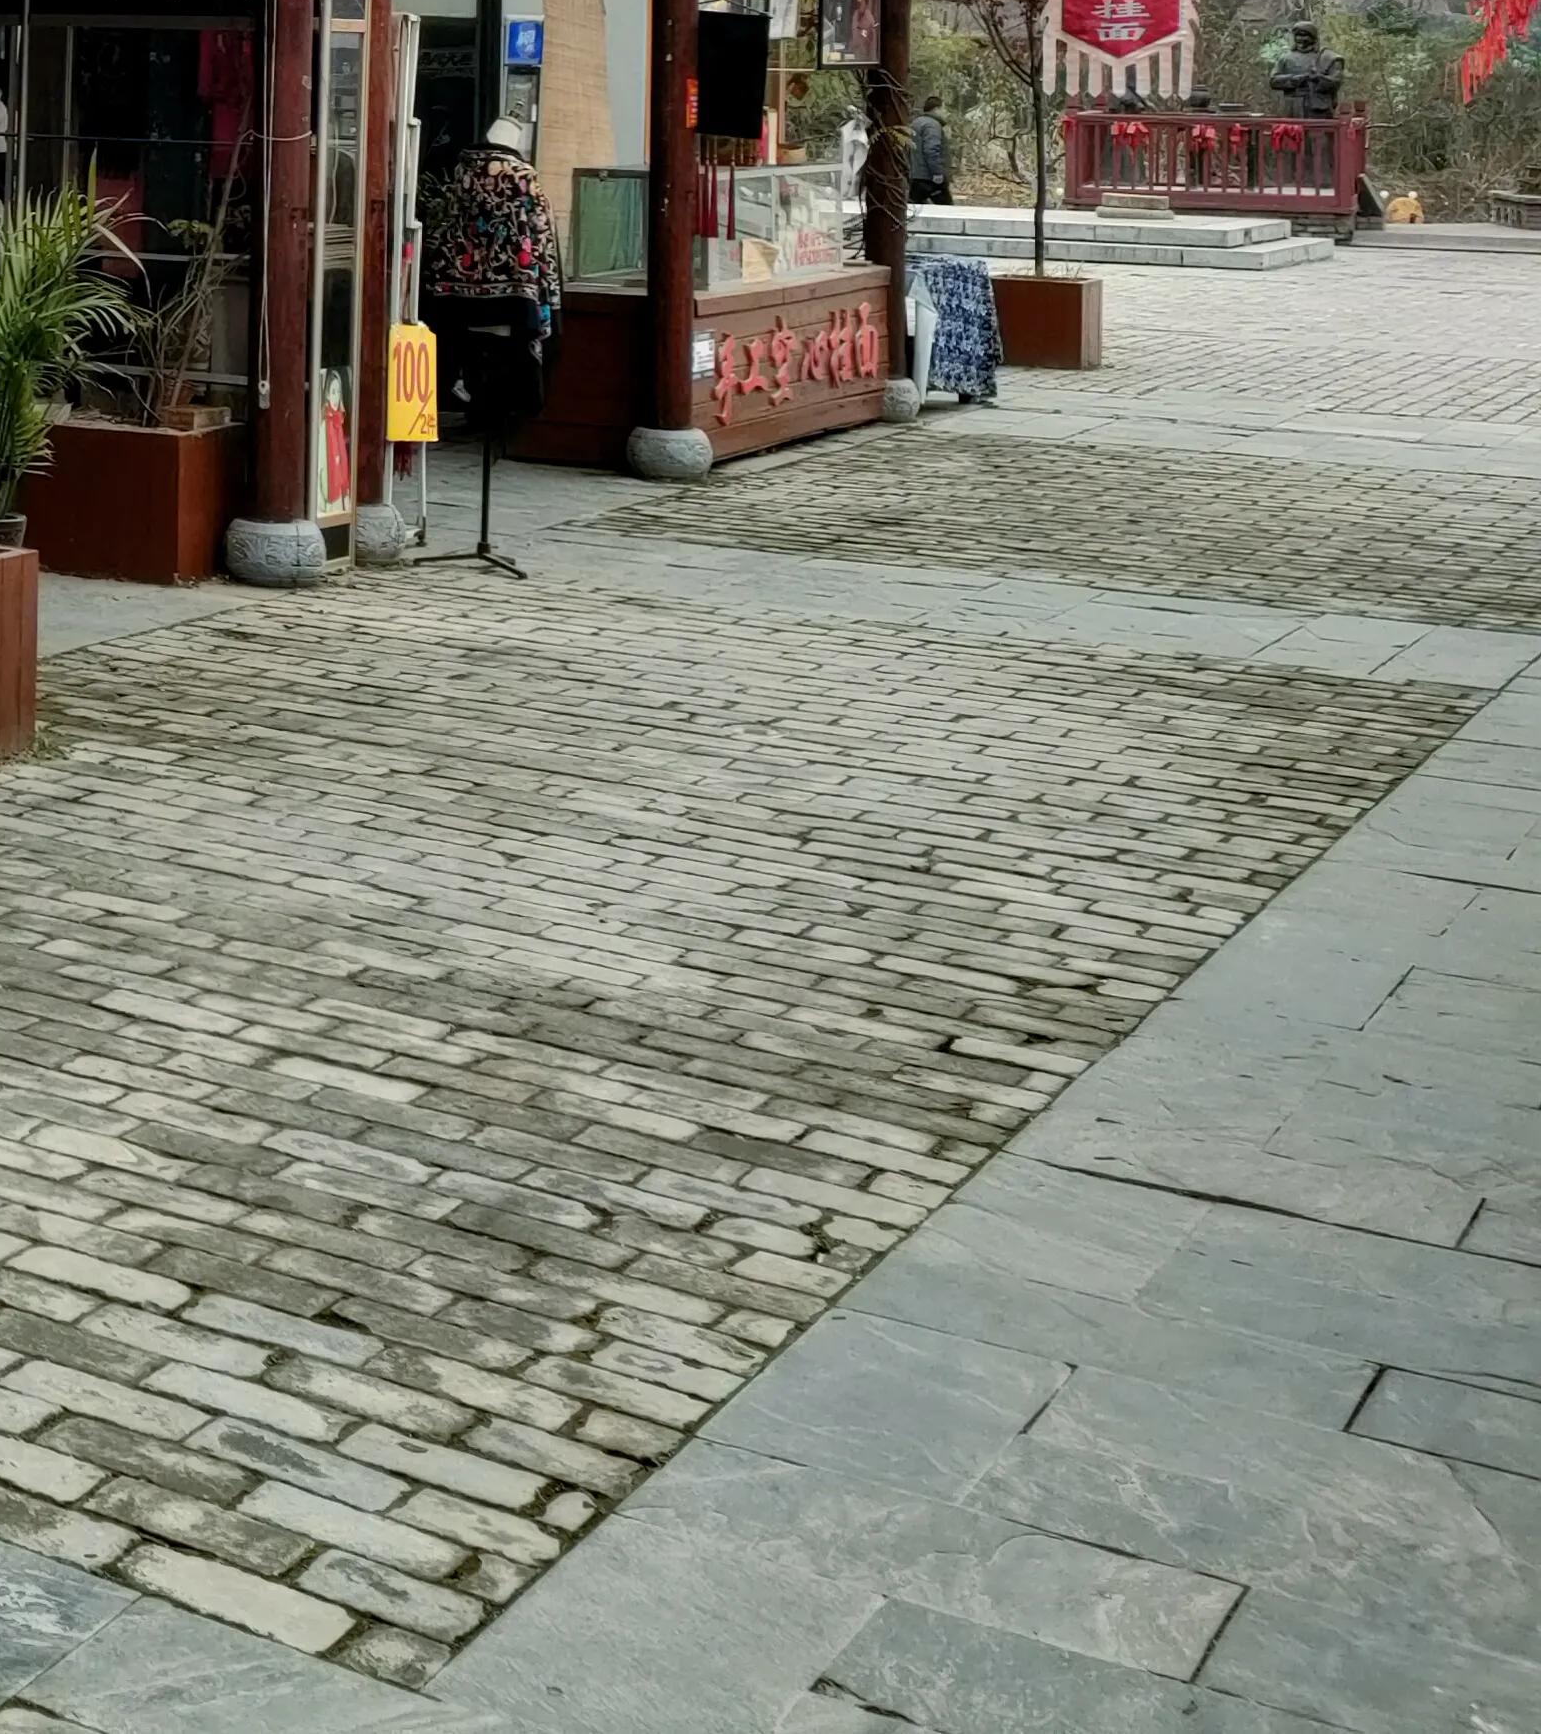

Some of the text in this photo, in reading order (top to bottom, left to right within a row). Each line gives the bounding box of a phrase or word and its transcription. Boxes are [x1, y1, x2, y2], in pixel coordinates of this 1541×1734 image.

[393, 341, 430, 403] 100
[715, 302, 880, 427] 手工空心挂面
